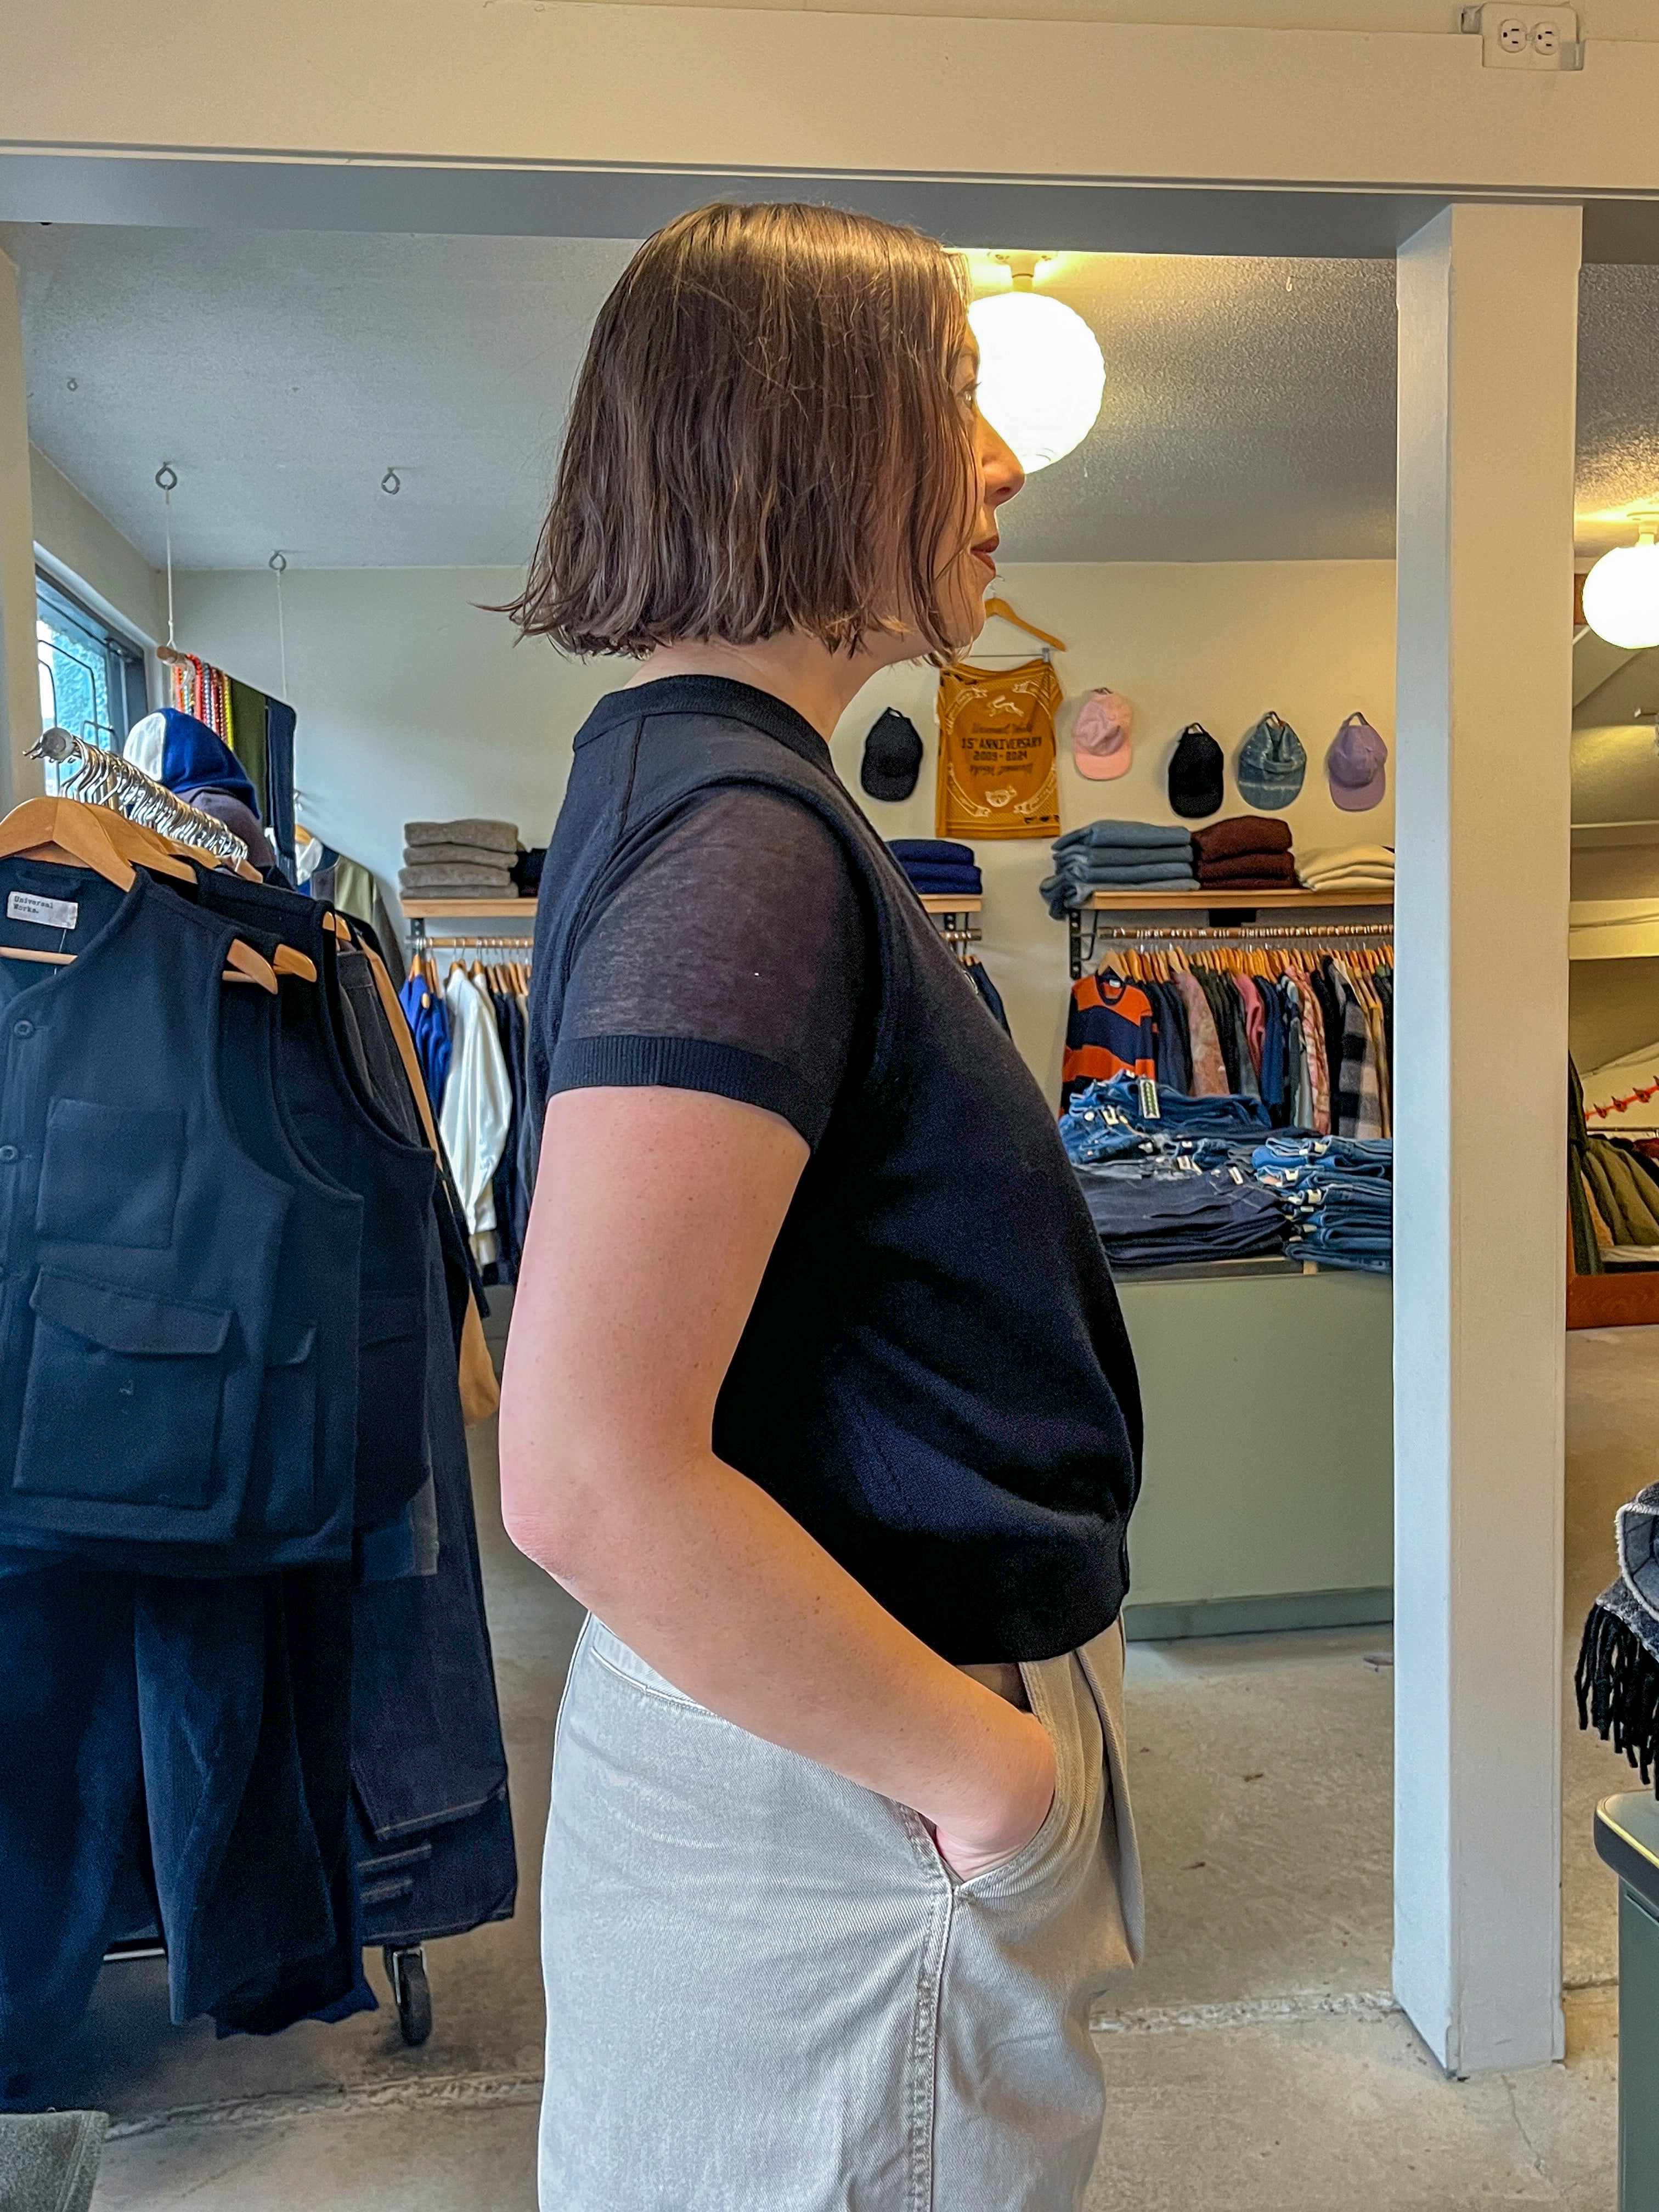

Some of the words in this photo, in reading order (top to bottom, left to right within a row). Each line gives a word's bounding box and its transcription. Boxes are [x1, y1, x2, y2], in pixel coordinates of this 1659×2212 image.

[979, 737, 1042, 749] ANNIVERSARY
[14, 895, 53, 909] Universal
[13, 904, 39, 913] Works.
